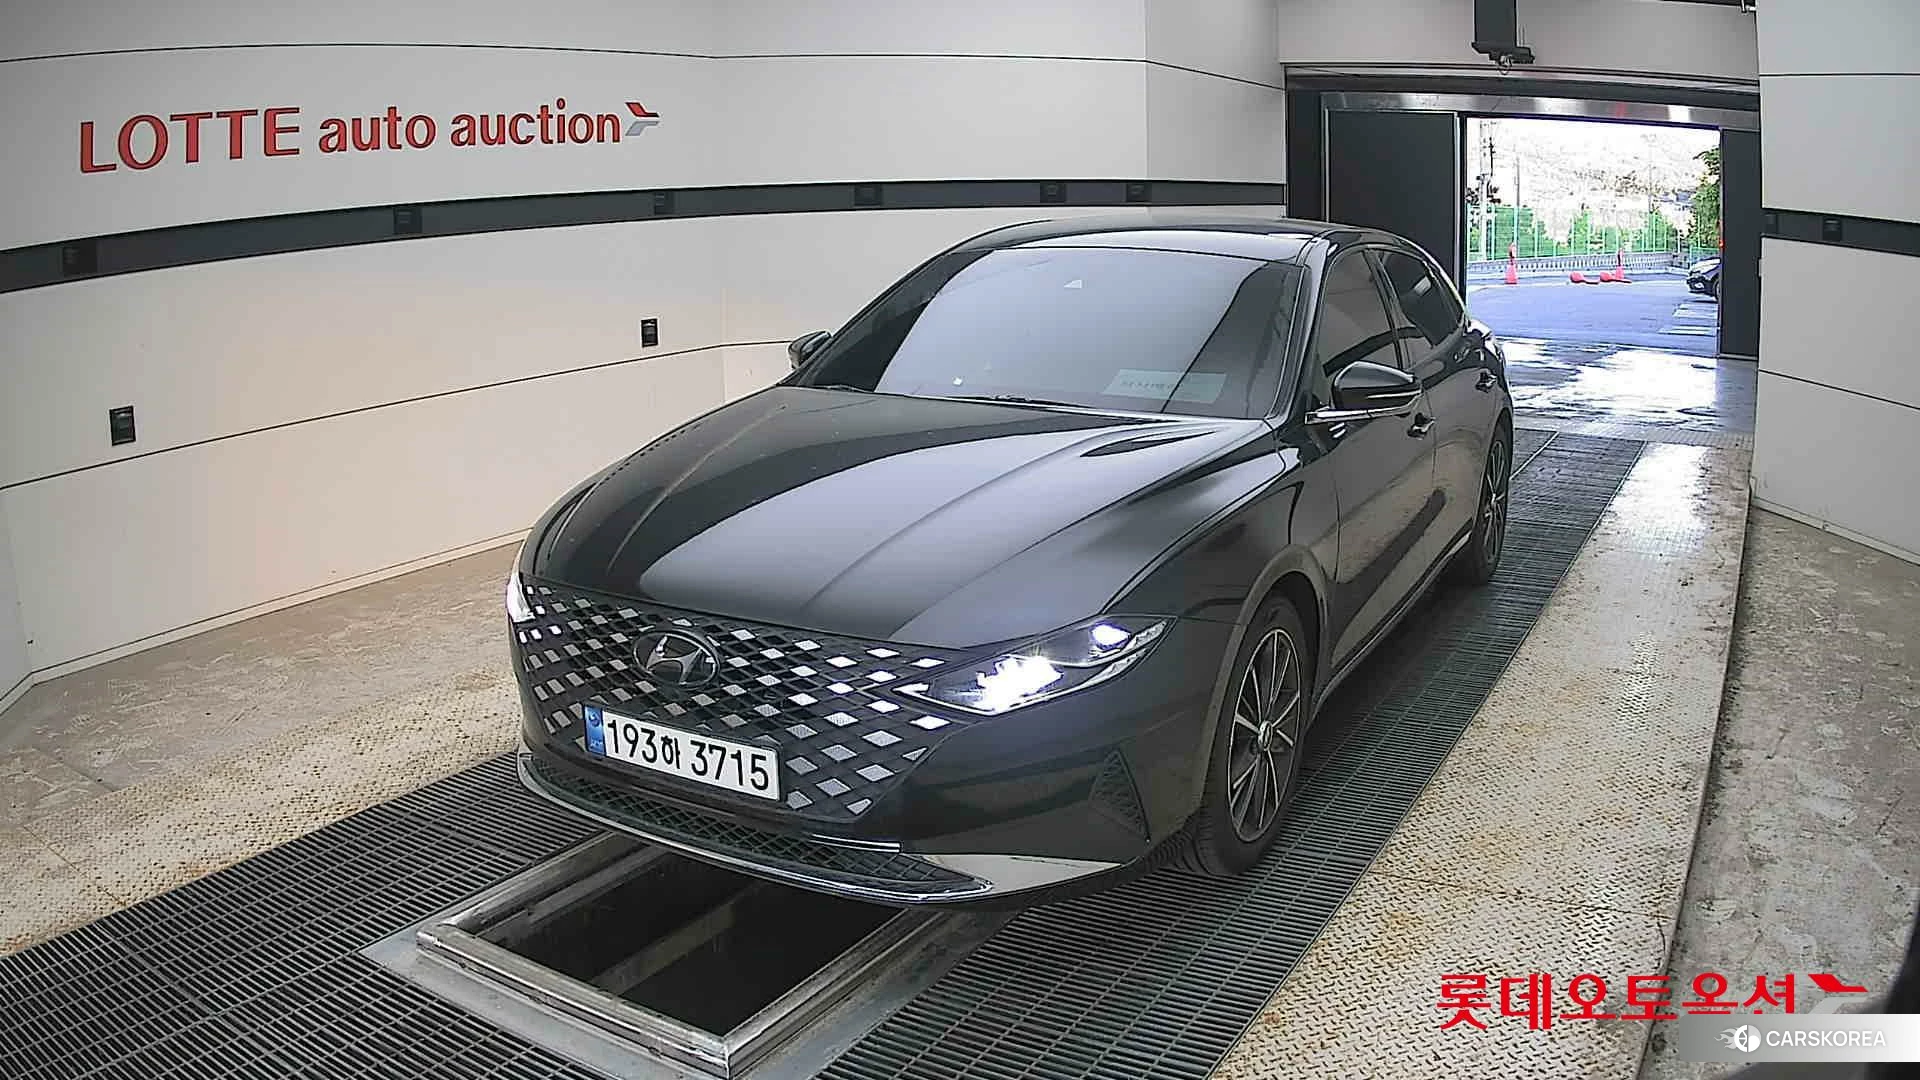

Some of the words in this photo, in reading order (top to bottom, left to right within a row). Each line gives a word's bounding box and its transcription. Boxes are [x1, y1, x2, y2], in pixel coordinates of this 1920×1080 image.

[80, 106, 299, 173] LOTTE
[319, 107, 436, 152] auto
[451, 98, 622, 146] auction
[607, 719, 681, 770] 193하
[690, 740, 769, 791] 3715
